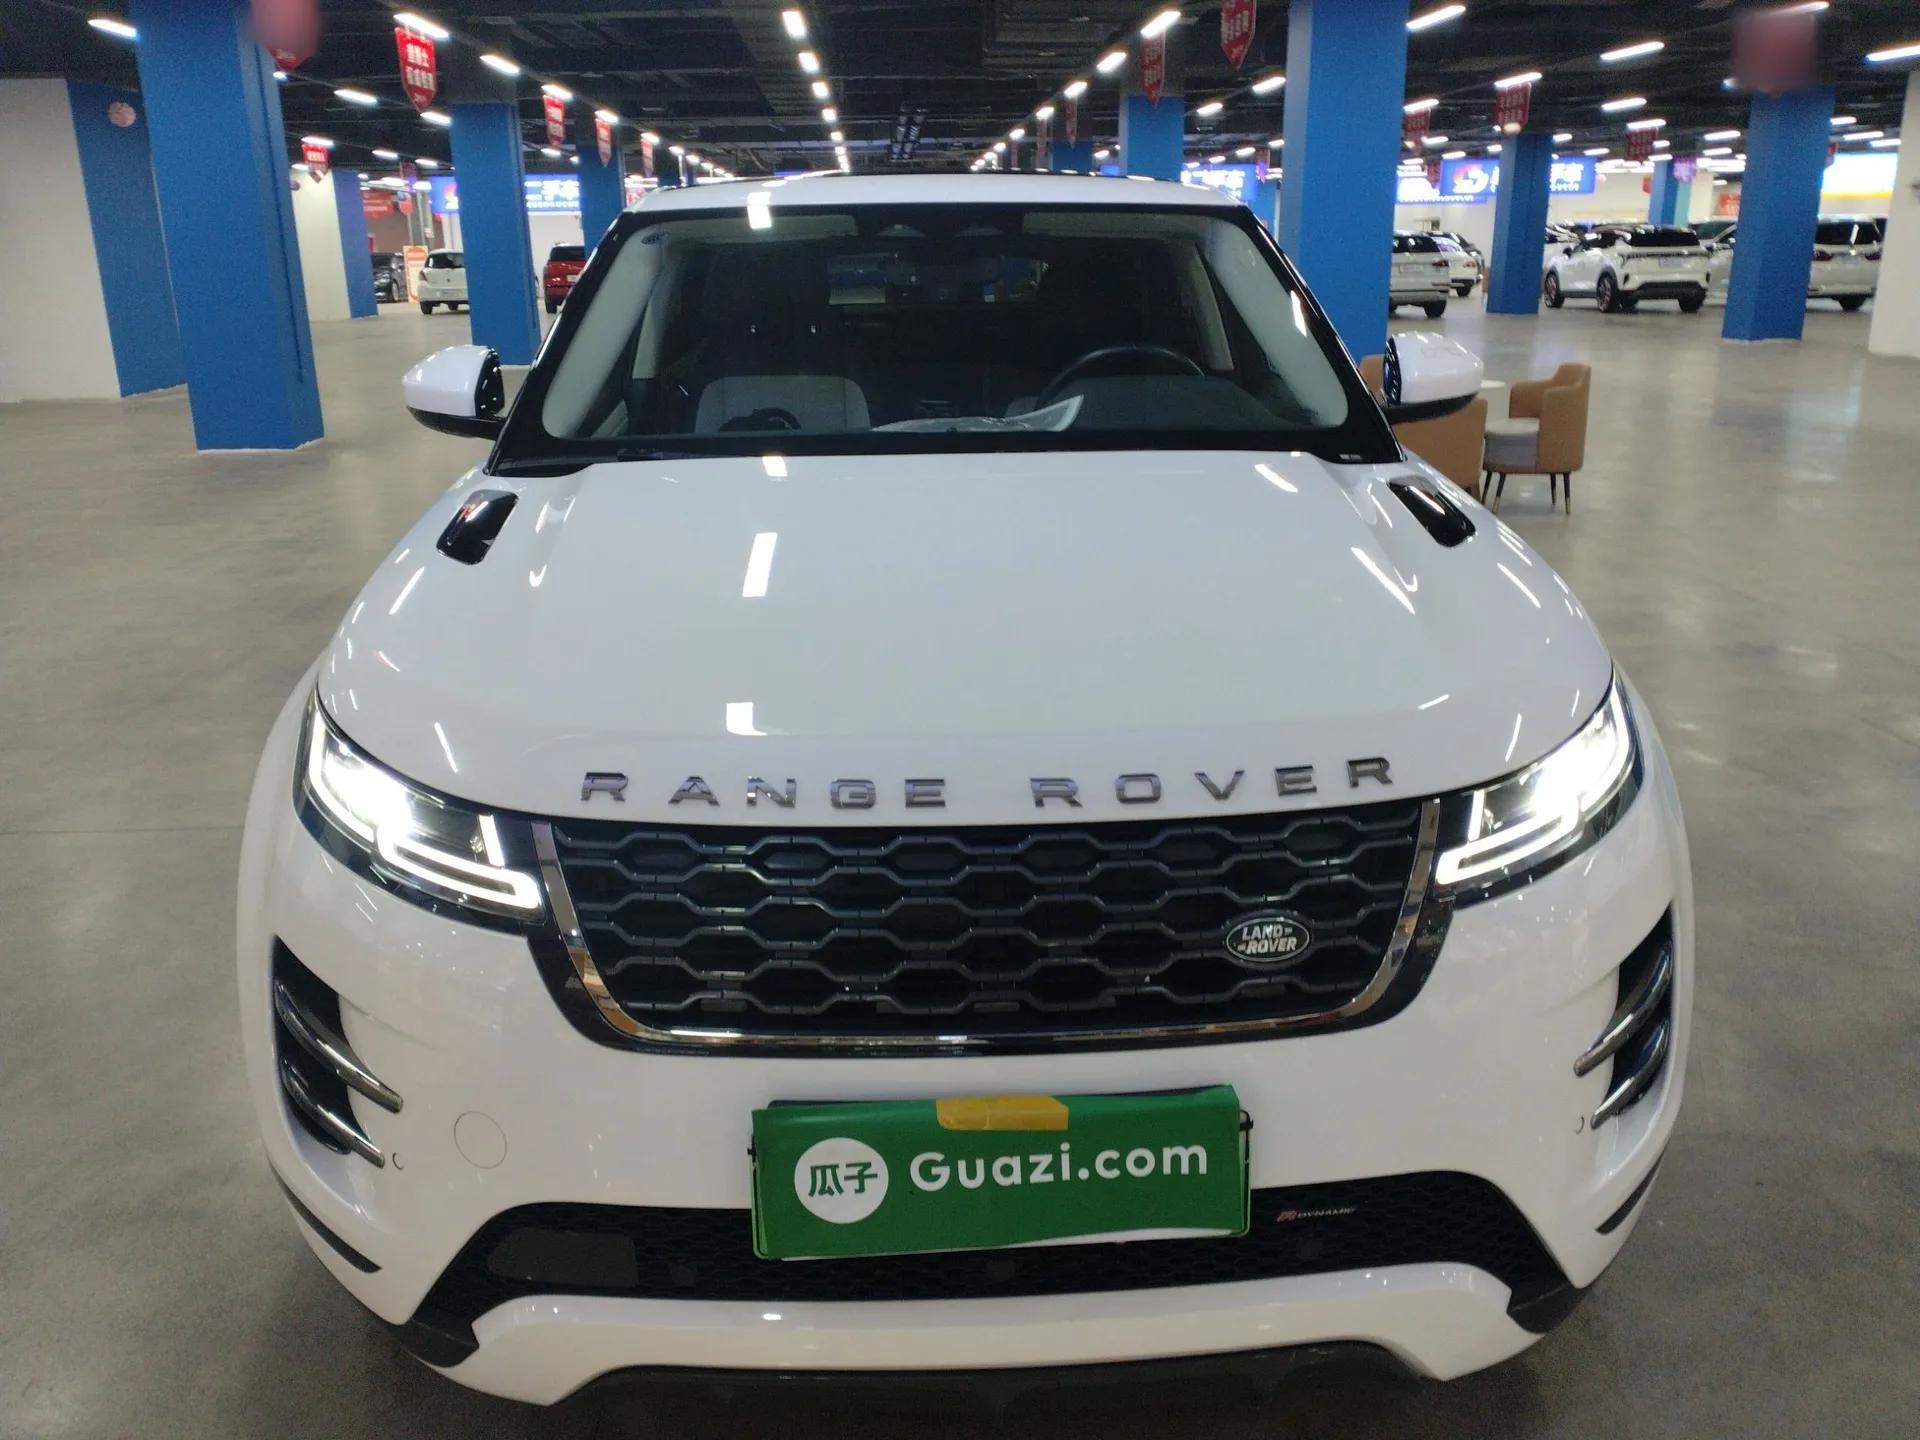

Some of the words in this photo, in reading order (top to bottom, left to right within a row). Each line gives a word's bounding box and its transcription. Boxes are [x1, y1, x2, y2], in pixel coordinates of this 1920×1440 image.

[580, 771, 947, 809] RANGE
[1029, 756, 1394, 808] ROVER
[806, 1161, 878, 1198] 瓜子
[909, 1142, 1208, 1192] Guazi.com
